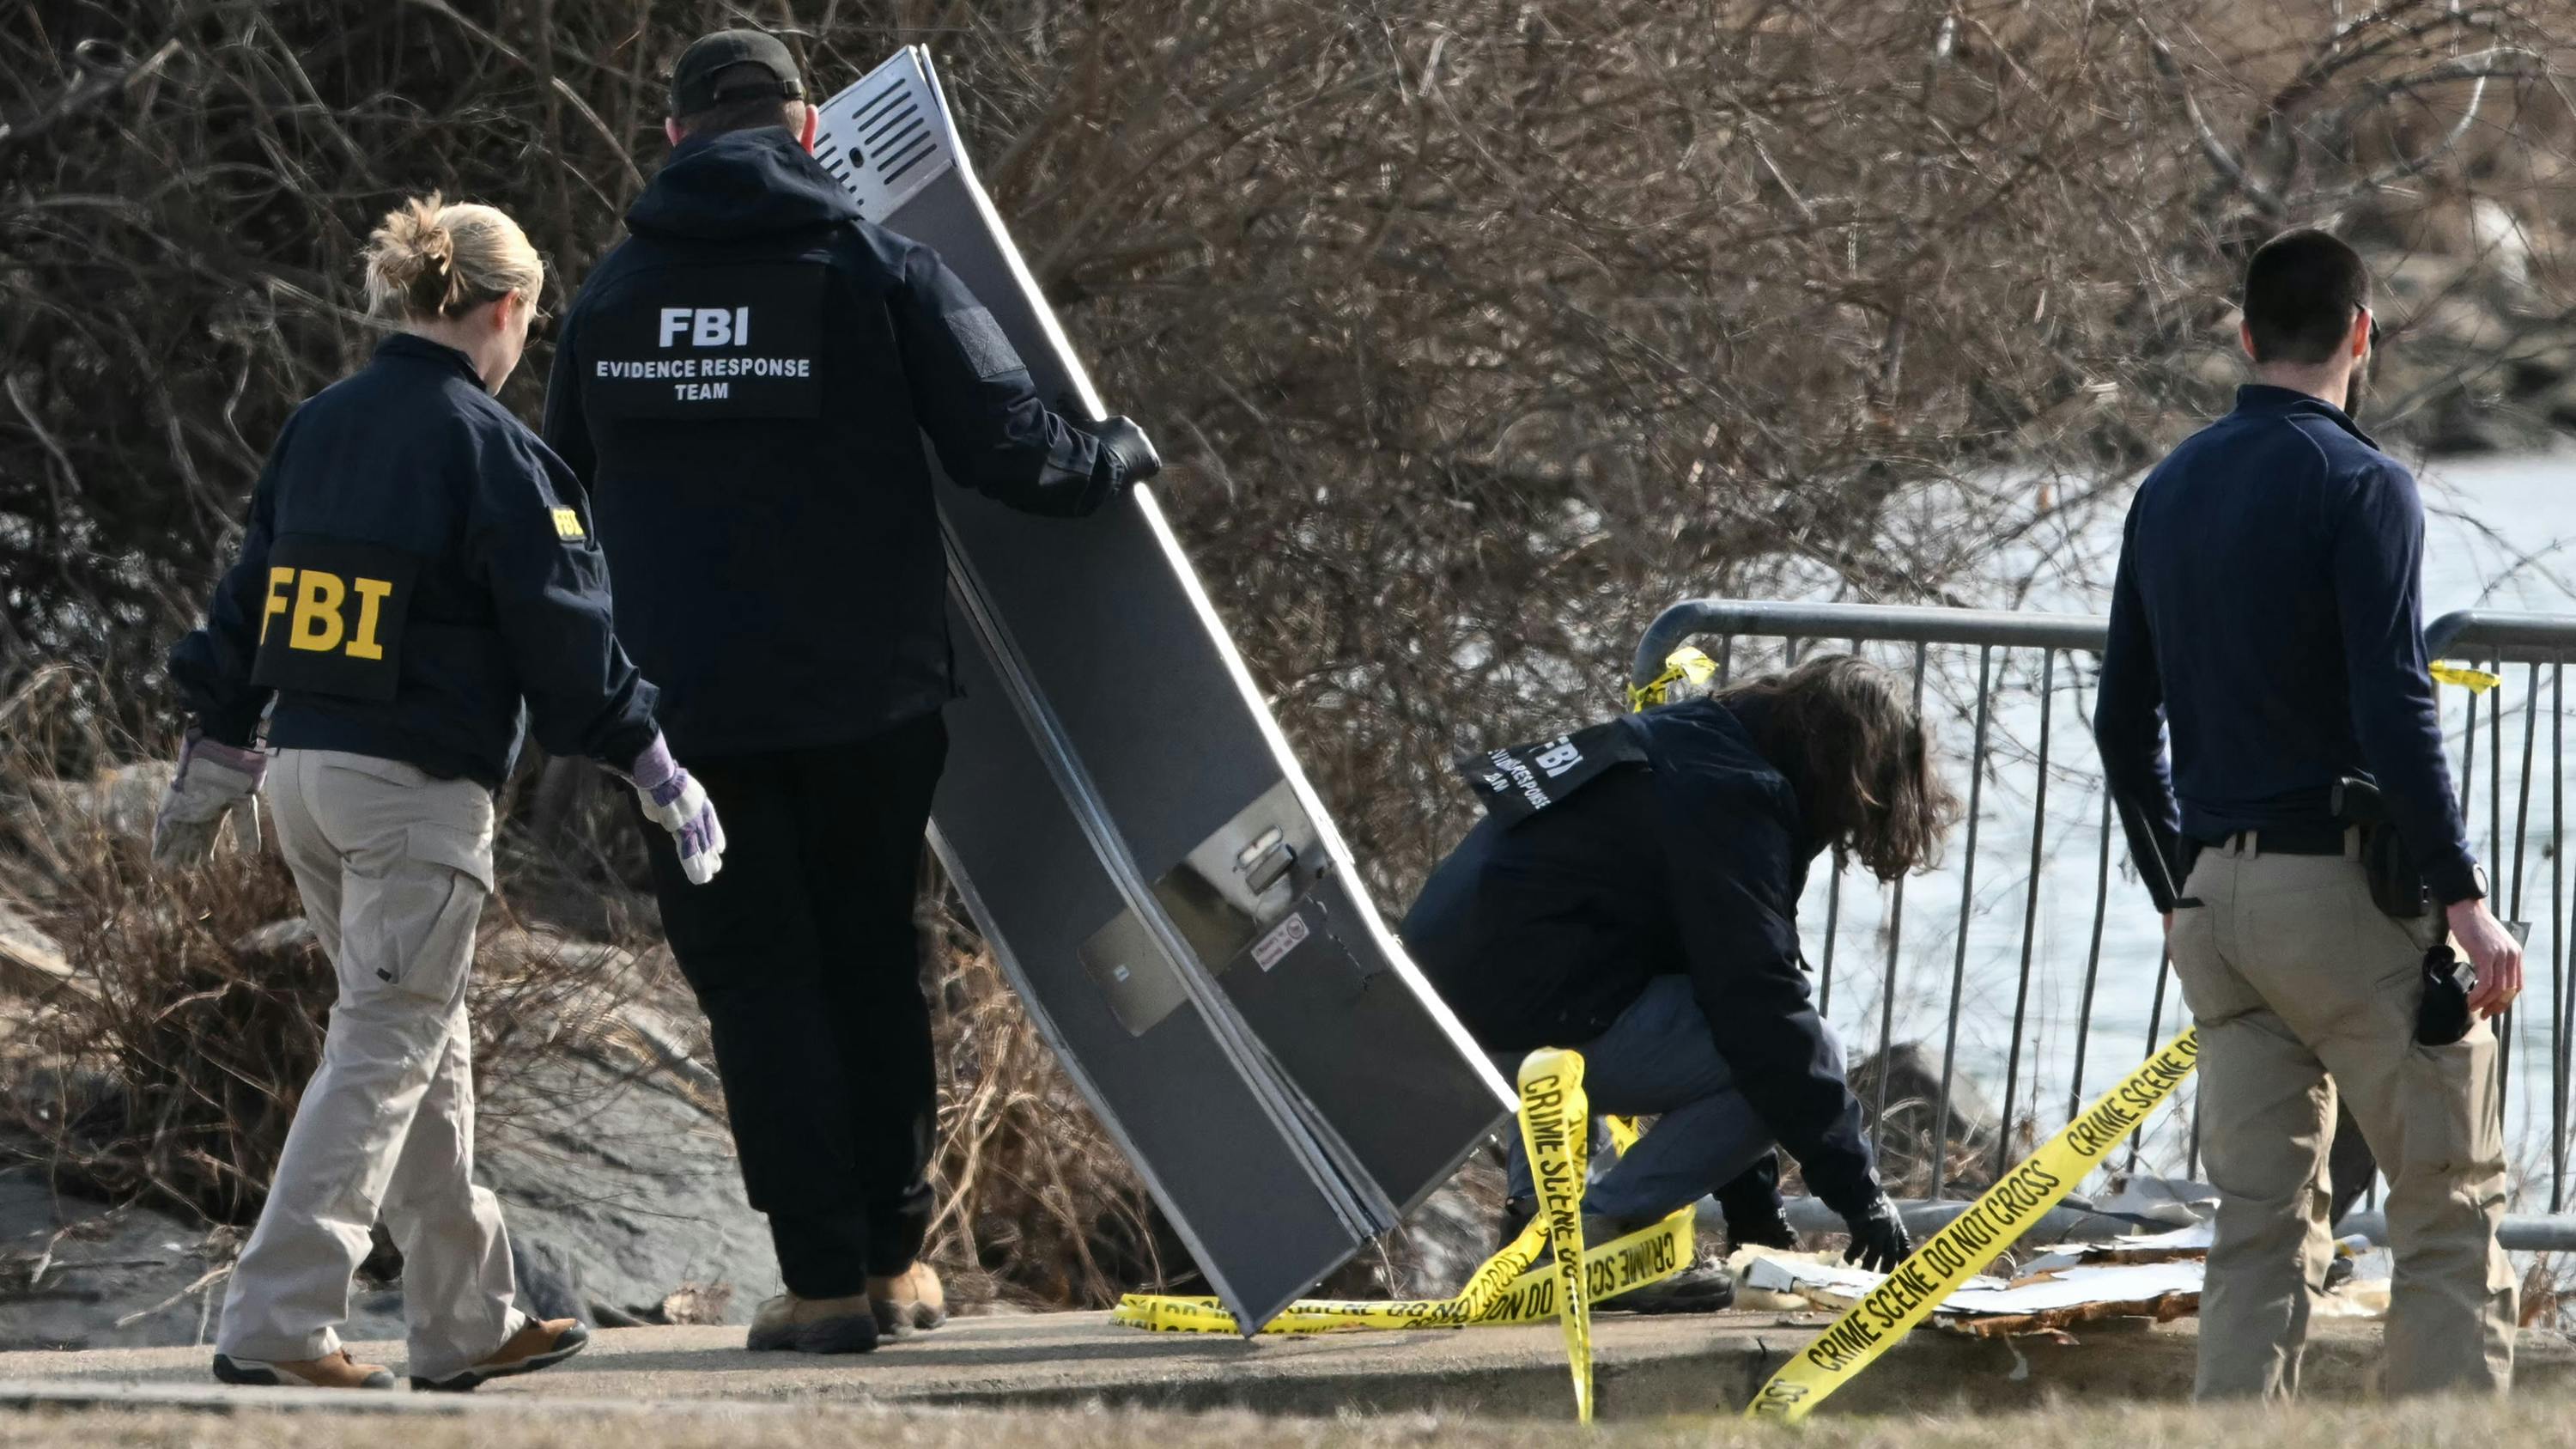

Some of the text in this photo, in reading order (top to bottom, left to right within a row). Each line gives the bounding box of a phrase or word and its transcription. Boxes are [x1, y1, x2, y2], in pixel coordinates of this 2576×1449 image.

[659, 307, 749, 347] FBI
[597, 358, 810, 378] EVIDENCE RESPONSE
[675, 383, 728, 400] TEAM
[553, 508, 584, 536] FBI
[260, 566, 392, 661] FBI
[1525, 1075, 1565, 1155] CRIME
[1540, 1160, 1575, 1241] SCENE
[1807, 1309, 1883, 1372] CRIME
[1865, 1260, 1940, 1329] SCENE
[1922, 1237, 1966, 1279] DO
[1948, 1207, 2001, 1257] NOT
[1985, 1160, 2061, 1226] CROSS
[2067, 1098, 2141, 1157] CRIME
[2120, 1052, 2196, 1109] SCENE
[1618, 1232, 1675, 1287] CRIME
[1525, 1276, 1552, 1318] DO
